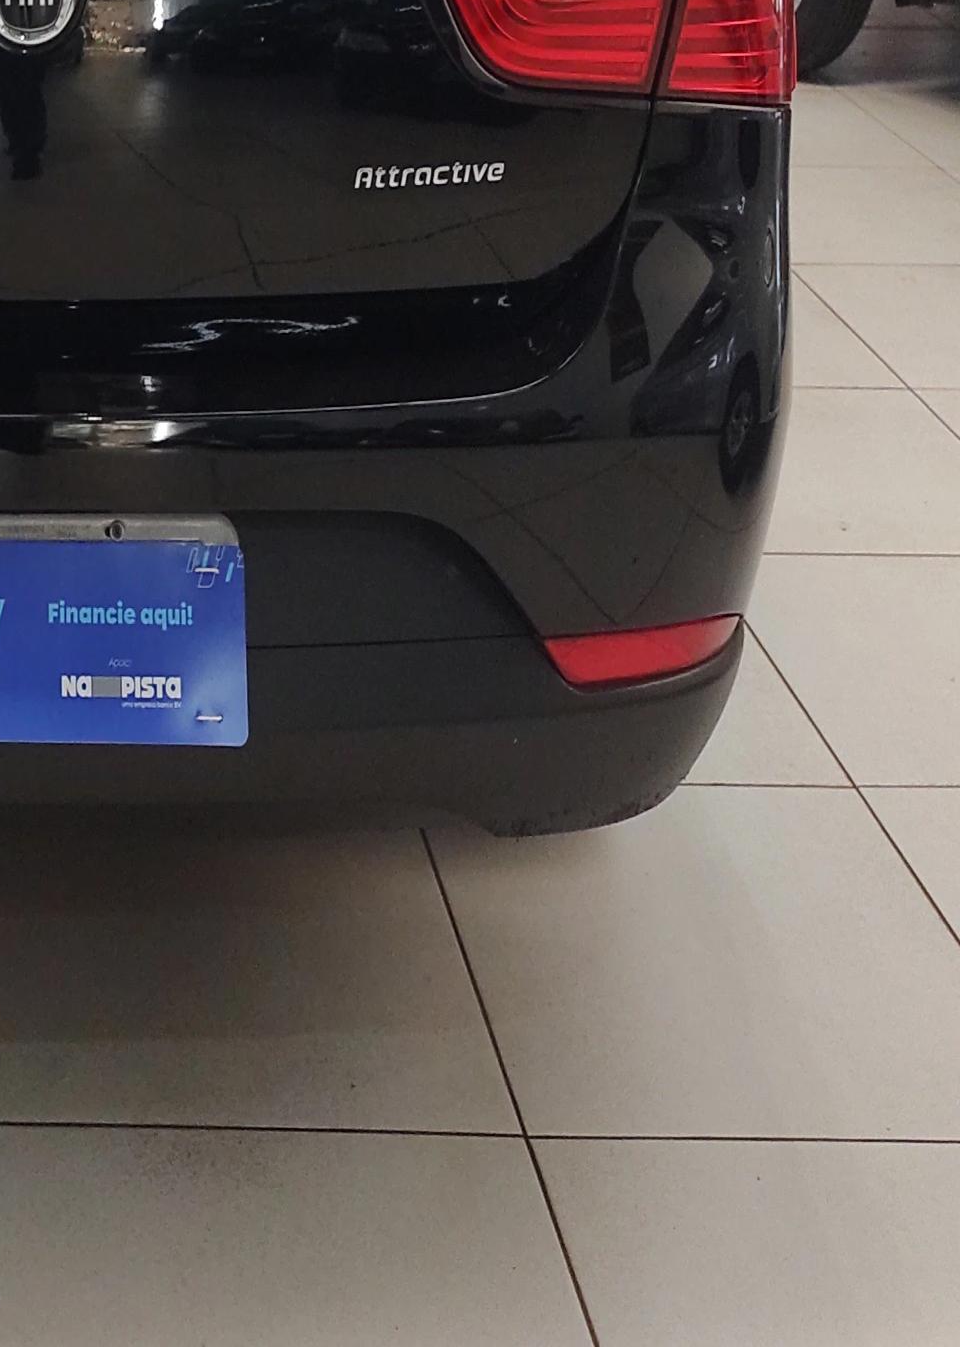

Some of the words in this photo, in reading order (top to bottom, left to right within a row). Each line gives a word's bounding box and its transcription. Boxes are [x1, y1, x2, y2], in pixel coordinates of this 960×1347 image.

[354, 161, 505, 189] Attractive
[48, 600, 136, 625] Financie
[140, 602, 194, 632] aqui!
